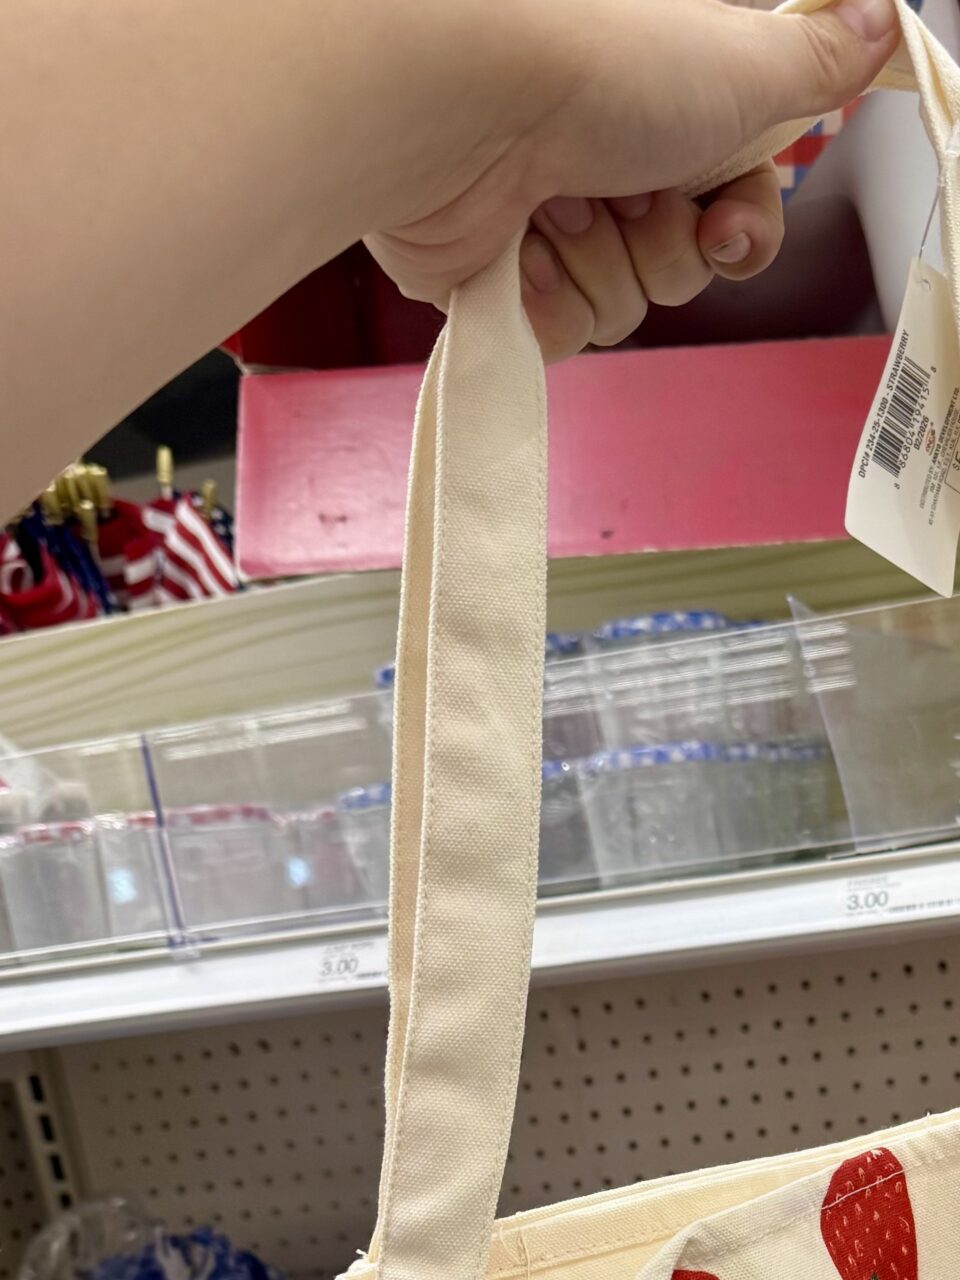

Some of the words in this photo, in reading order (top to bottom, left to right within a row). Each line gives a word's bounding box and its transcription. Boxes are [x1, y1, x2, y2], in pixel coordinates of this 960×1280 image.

[858, 450, 870, 478] DPCI#
[865, 397, 889, 451] 234-25-1300
[887, 329, 909, 391] STRAWBERRY
[900, 430, 915, 468] 86804
[913, 386, 930, 423] 19415
[914, 416, 930, 450] 02/2026
[939, 402, 956, 443] DEVELOPMENT
[847, 890, 889, 911] 3.00
[320, 957, 359, 977] 3.00
